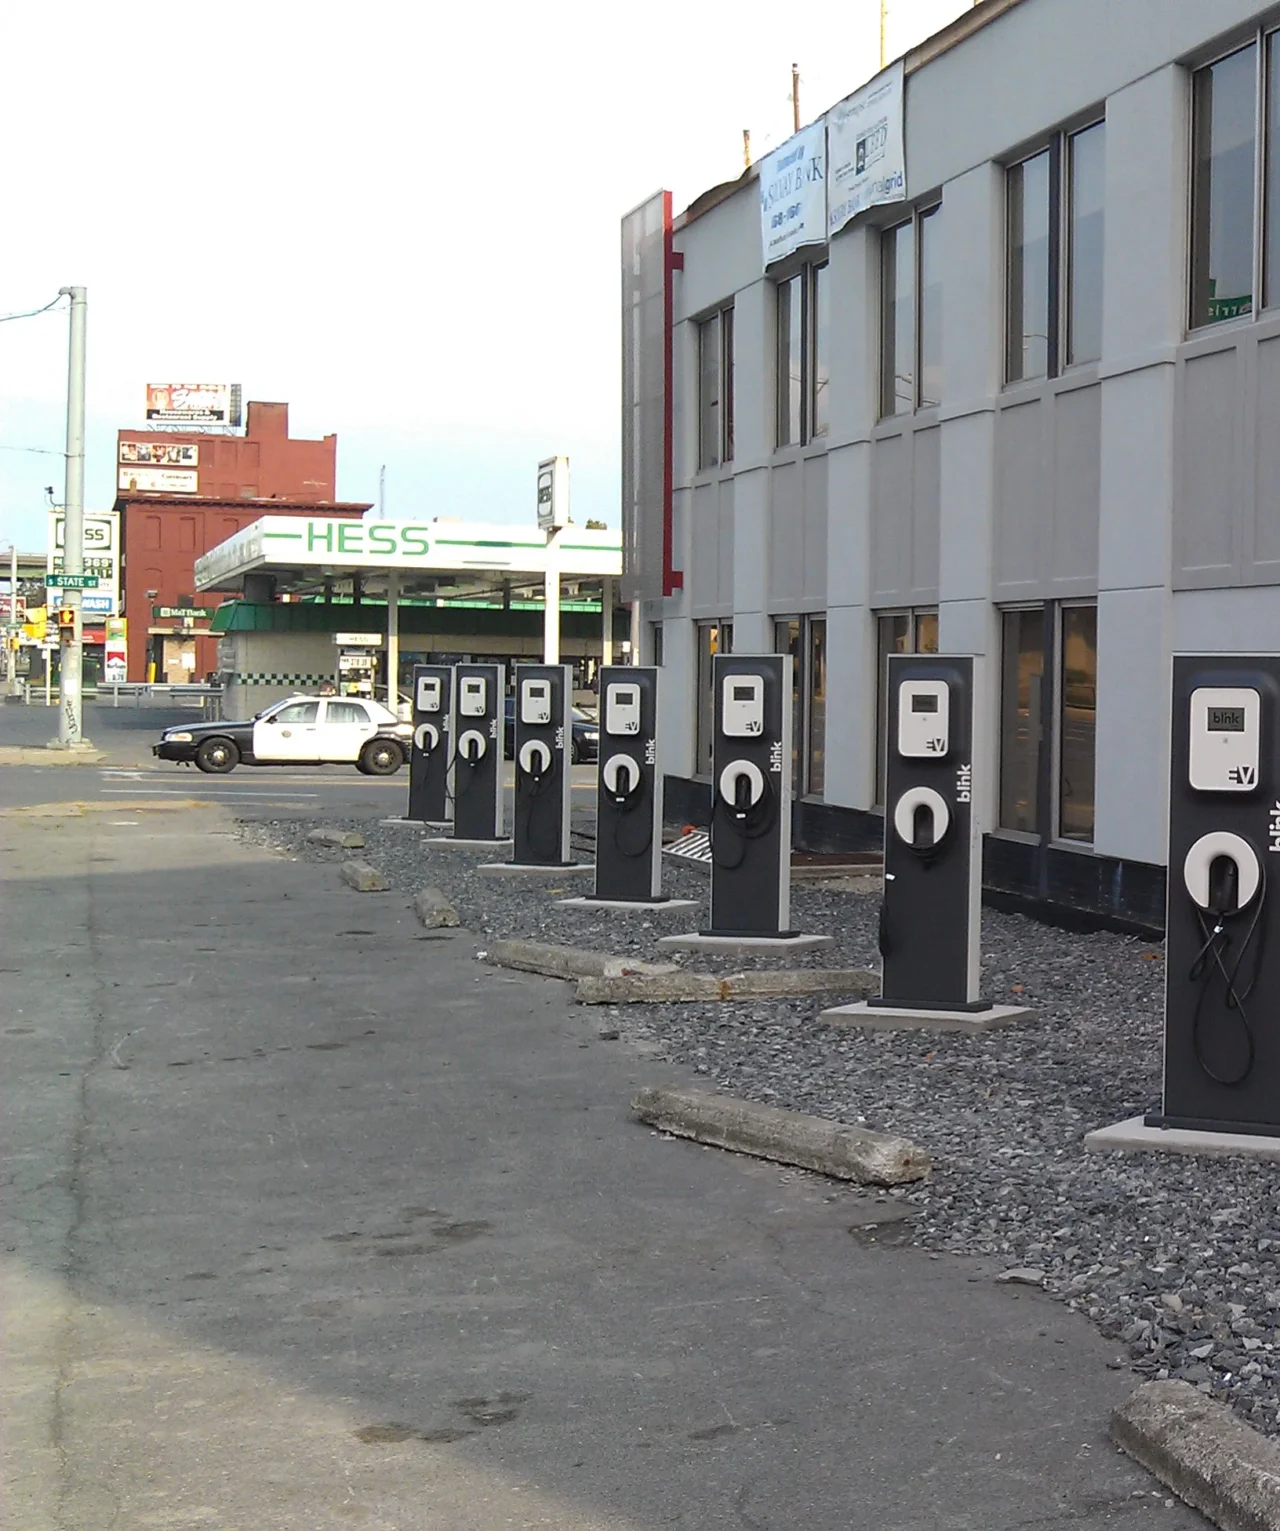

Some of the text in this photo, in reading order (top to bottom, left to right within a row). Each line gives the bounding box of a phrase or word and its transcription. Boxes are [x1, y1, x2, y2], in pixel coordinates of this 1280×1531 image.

[84, 528, 104, 541] SS
[307, 521, 430, 556] HESS
[57, 577, 84, 587] STATE
[1213, 712, 1240, 725] blink
[555, 726, 564, 749] blink
[645, 738, 656, 765] blink
[770, 741, 782, 772] blink
[957, 763, 972, 803] blink
